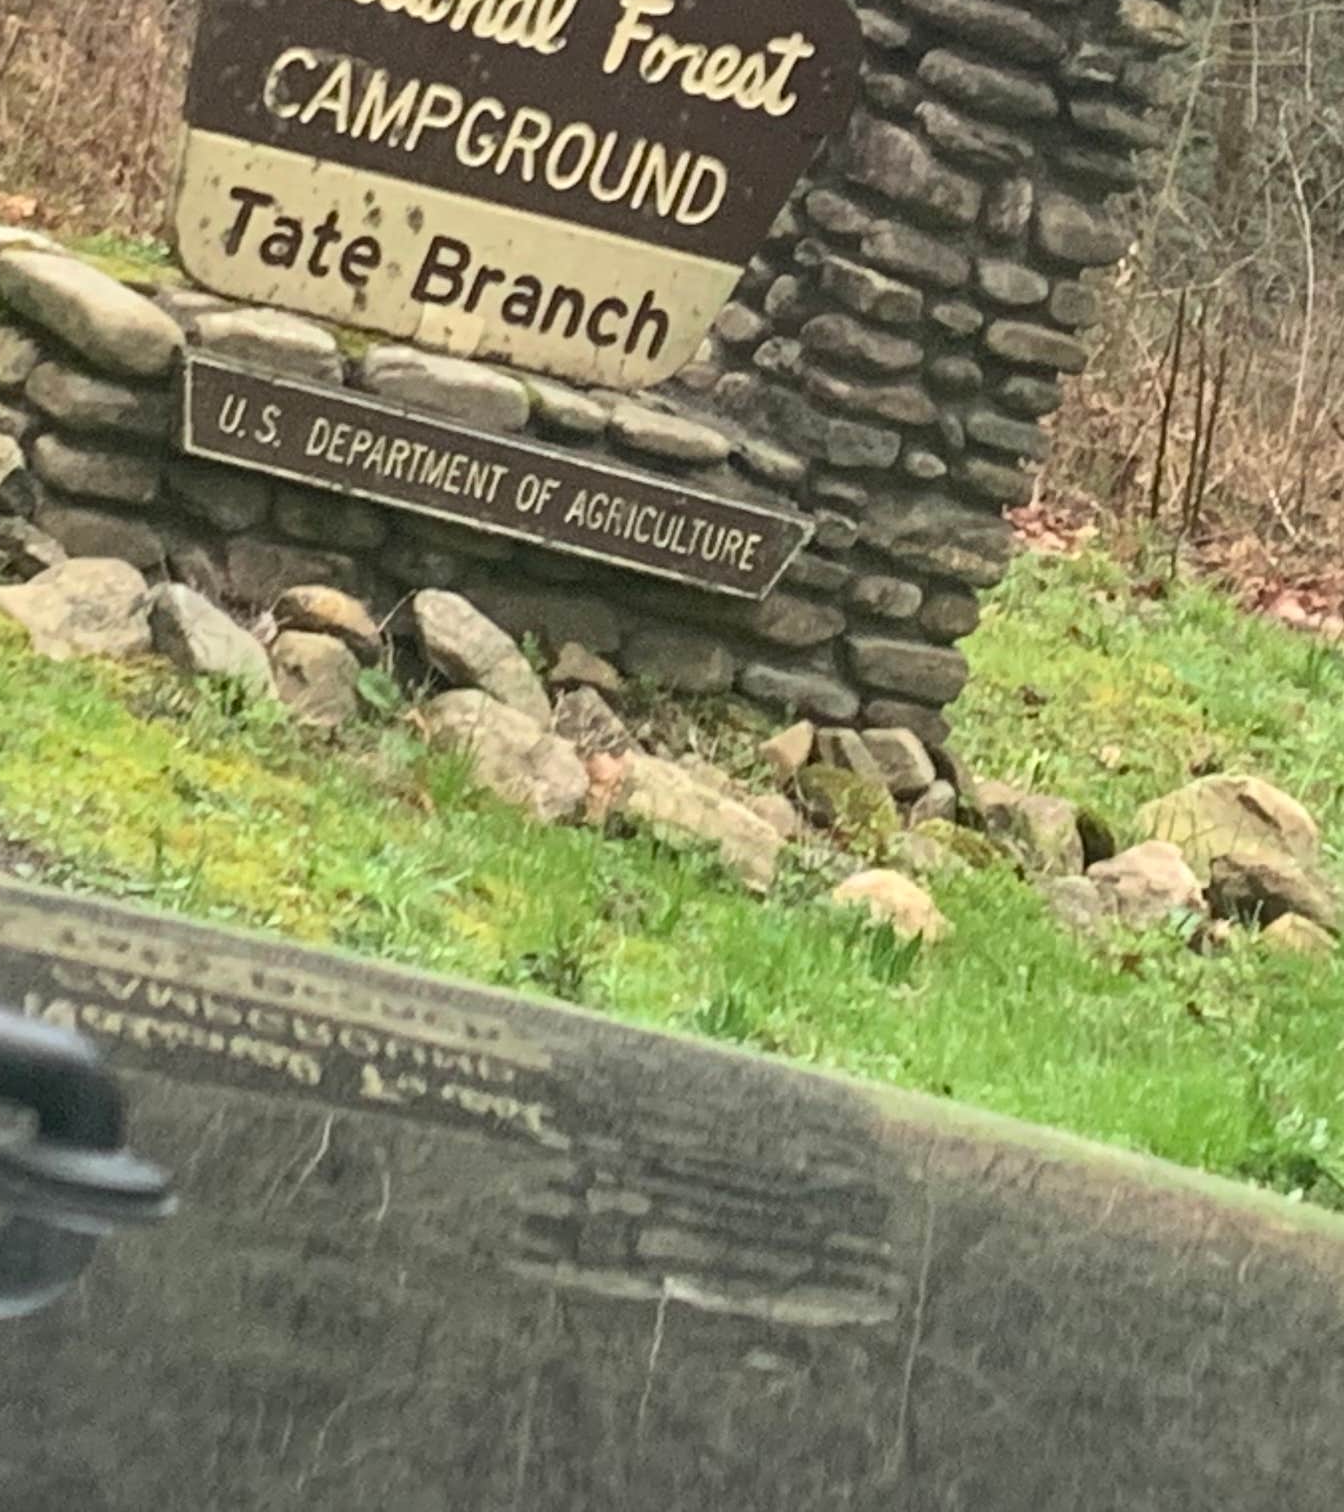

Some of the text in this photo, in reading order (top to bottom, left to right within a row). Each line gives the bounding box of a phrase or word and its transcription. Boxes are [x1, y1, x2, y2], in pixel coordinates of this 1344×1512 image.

[263, 46, 729, 227] CAMPGROUND
[222, 186, 670, 360] Tate Branch
[218, 394, 763, 572] U.S. DEPARTMENT OF AGRICULTURE
